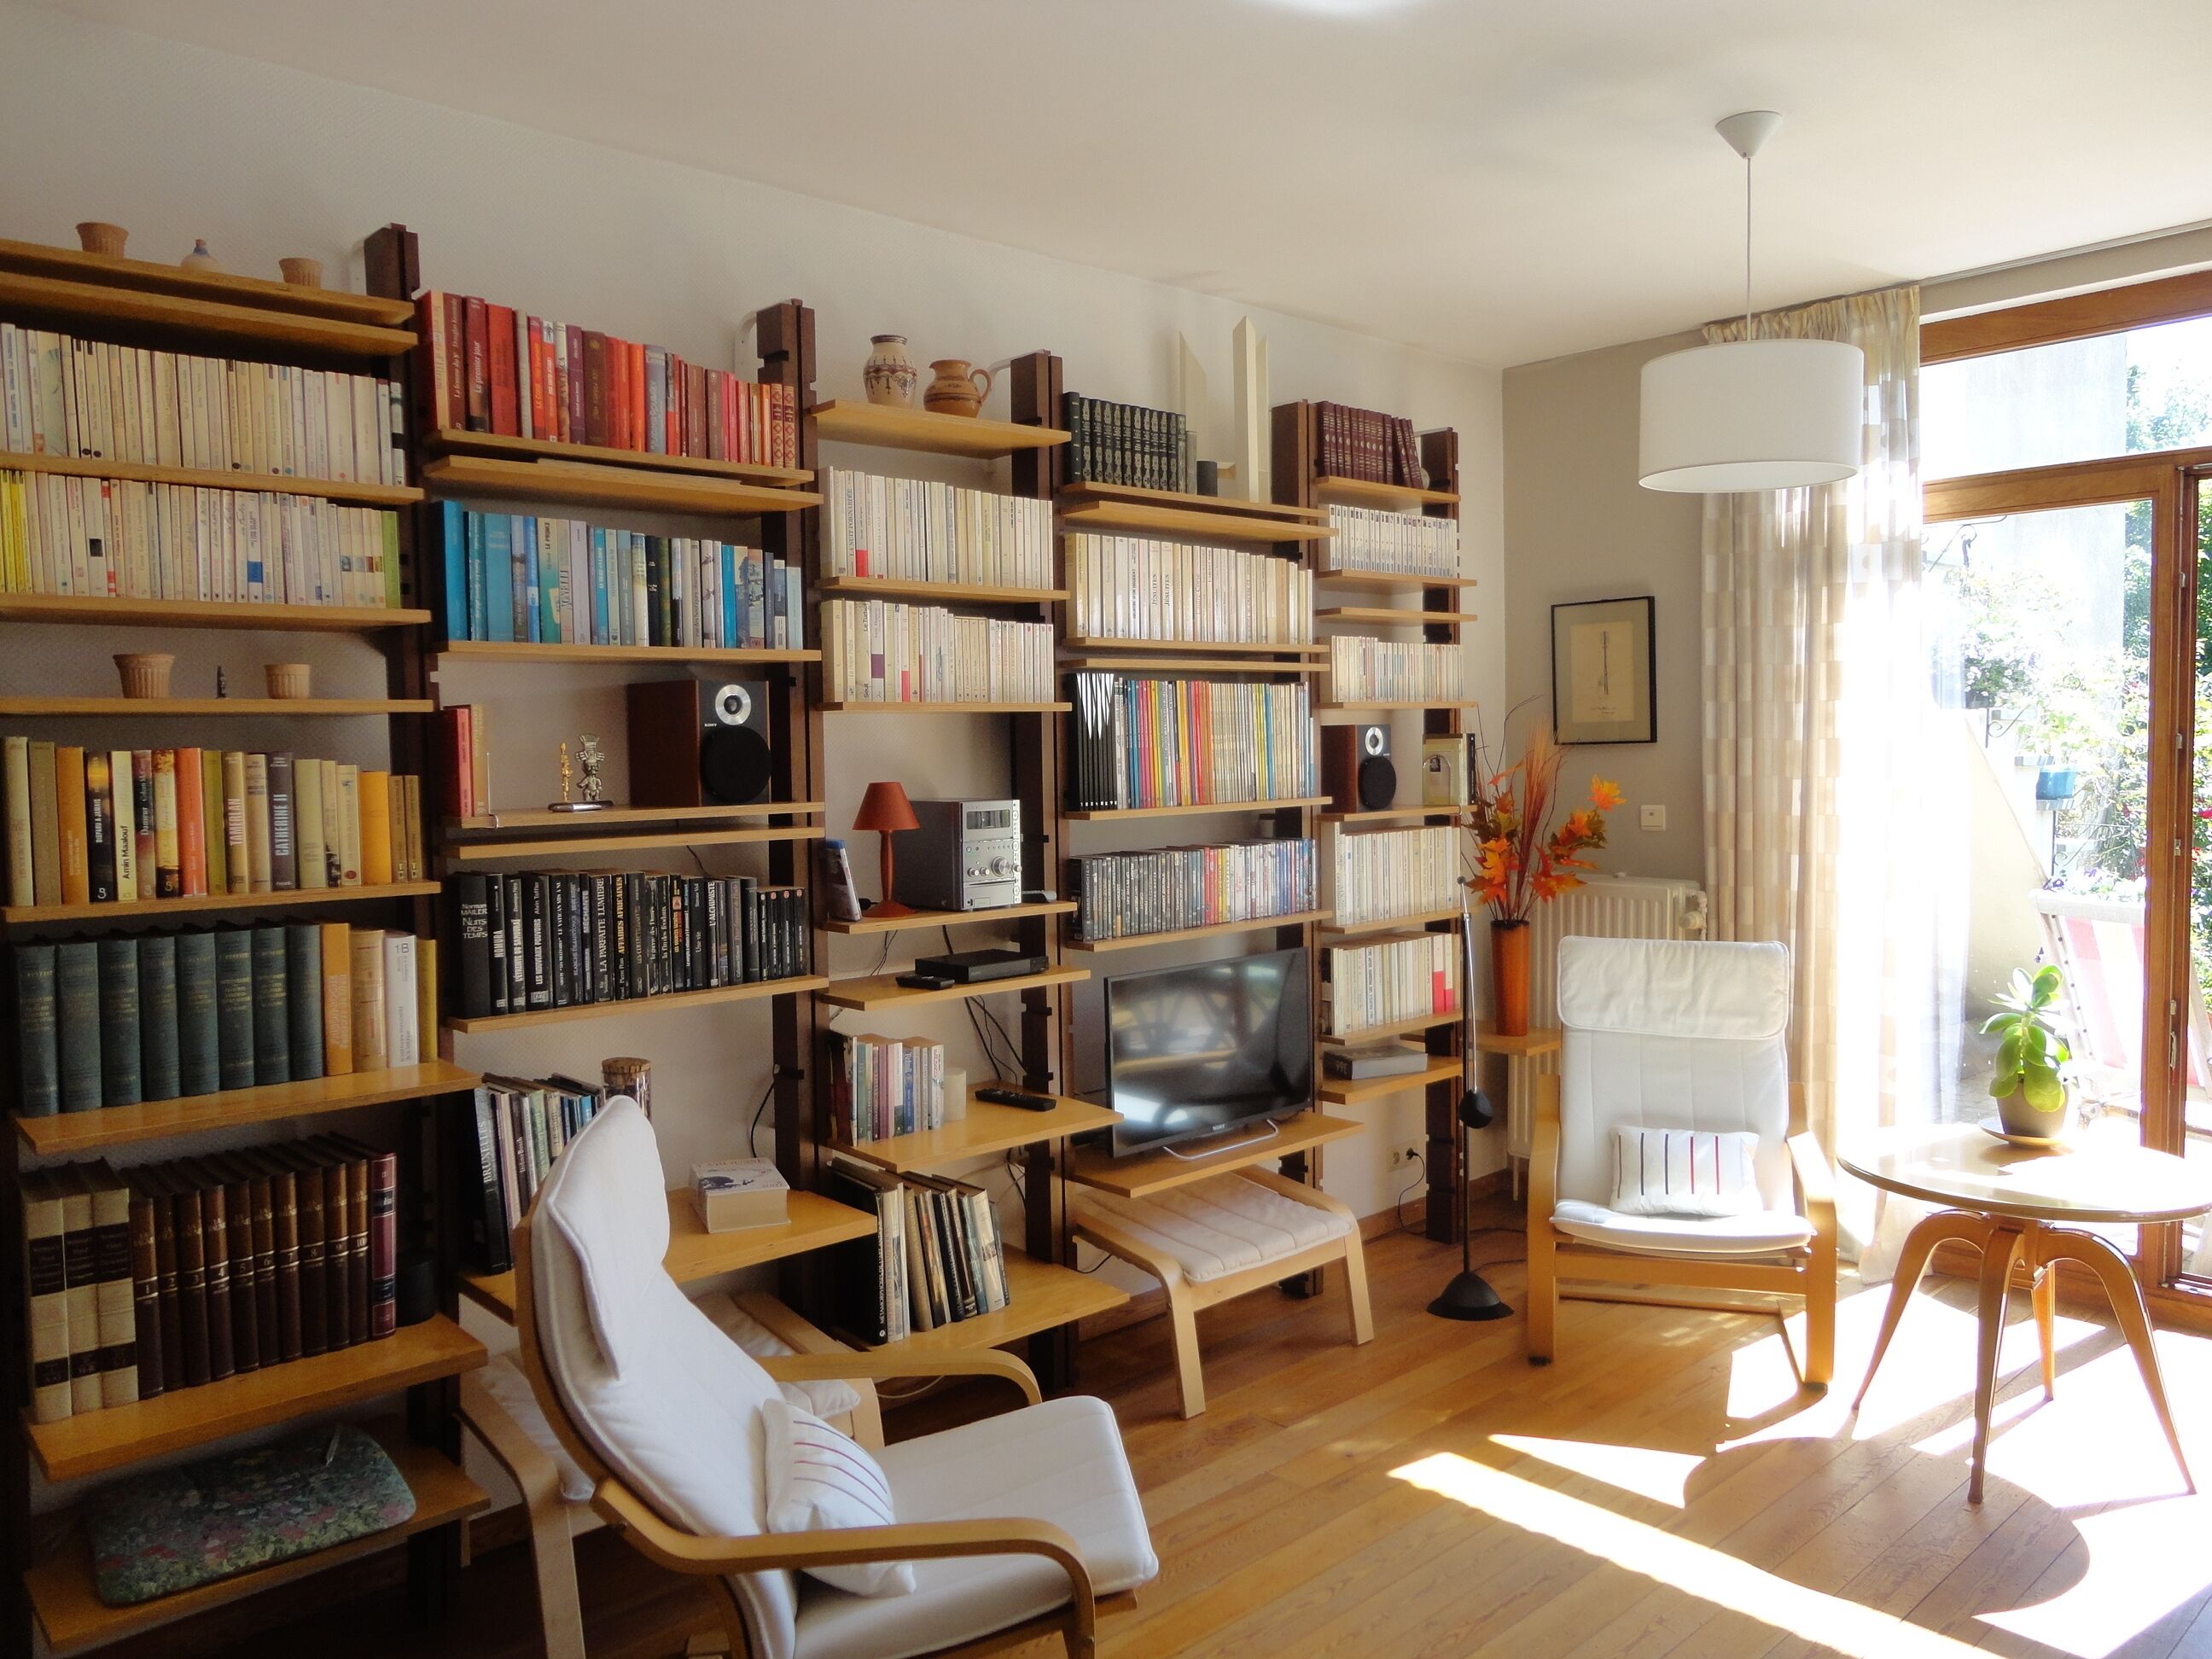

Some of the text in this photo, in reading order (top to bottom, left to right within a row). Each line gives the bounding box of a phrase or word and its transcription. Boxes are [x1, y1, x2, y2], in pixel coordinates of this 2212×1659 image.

[473, 341, 483, 394] Le premier jour
[92, 799, 102, 818] JAMAIS
[140, 806, 150, 836] Danseur
[228, 798, 244, 847] TAMERLAN
[272, 794, 290, 857] CATHERINE II
[93, 822, 104, 843] DISPARU
[119, 825, 131, 879] Amin Maalouf
[615, 876, 625, 920] AFRICAINES
[707, 881, 717, 927] L'ALCHIMISTE
[461, 908, 488, 917] MAILER
[581, 890, 591, 934] MÉCHANTE
[462, 932, 488, 940] TEMPS
[533, 918, 543, 946] POUVOIRS
[597, 918, 608, 958] PARFAITE
[616, 920, 625, 954] AFFAIRES
[492, 929, 505, 958] NOMURA
[533, 946, 544, 975] NOUVEAUX
[598, 960, 608, 973] LA
[534, 975, 544, 985] LES
[477, 1121, 493, 1185] BRUXELLES
[310, 1248, 319, 1258] 8
[356, 1237, 367, 1248] 10
[239, 1262, 247, 1273] 5
[263, 1256, 273, 1266] 6
[288, 1253, 295, 1263] 7
[167, 1277, 176, 1287] 2
[193, 1273, 200, 1284] 3
[218, 1266, 225, 1277] 4
[144, 1284, 150, 1295] 1
